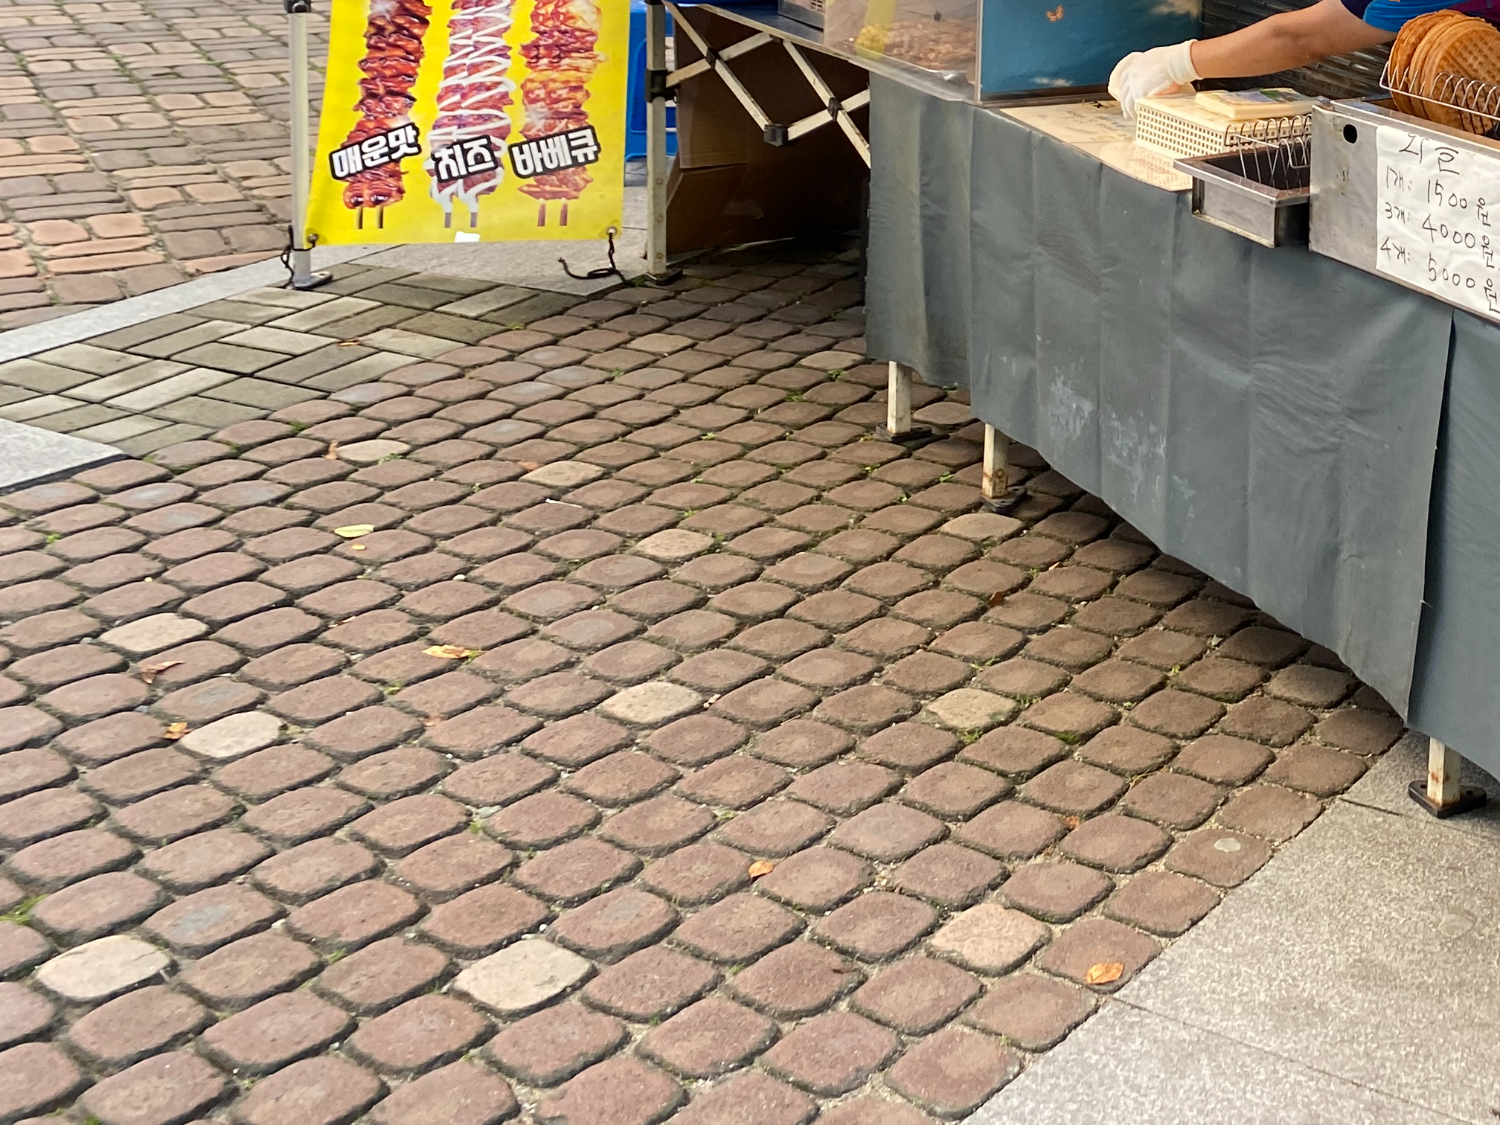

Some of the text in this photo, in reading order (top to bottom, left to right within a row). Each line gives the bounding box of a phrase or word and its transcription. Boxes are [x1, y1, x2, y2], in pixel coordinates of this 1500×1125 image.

[331, 125, 420, 178] 매운맛
[434, 137, 496, 181] 치즈
[511, 127, 599, 176] 바베큐
